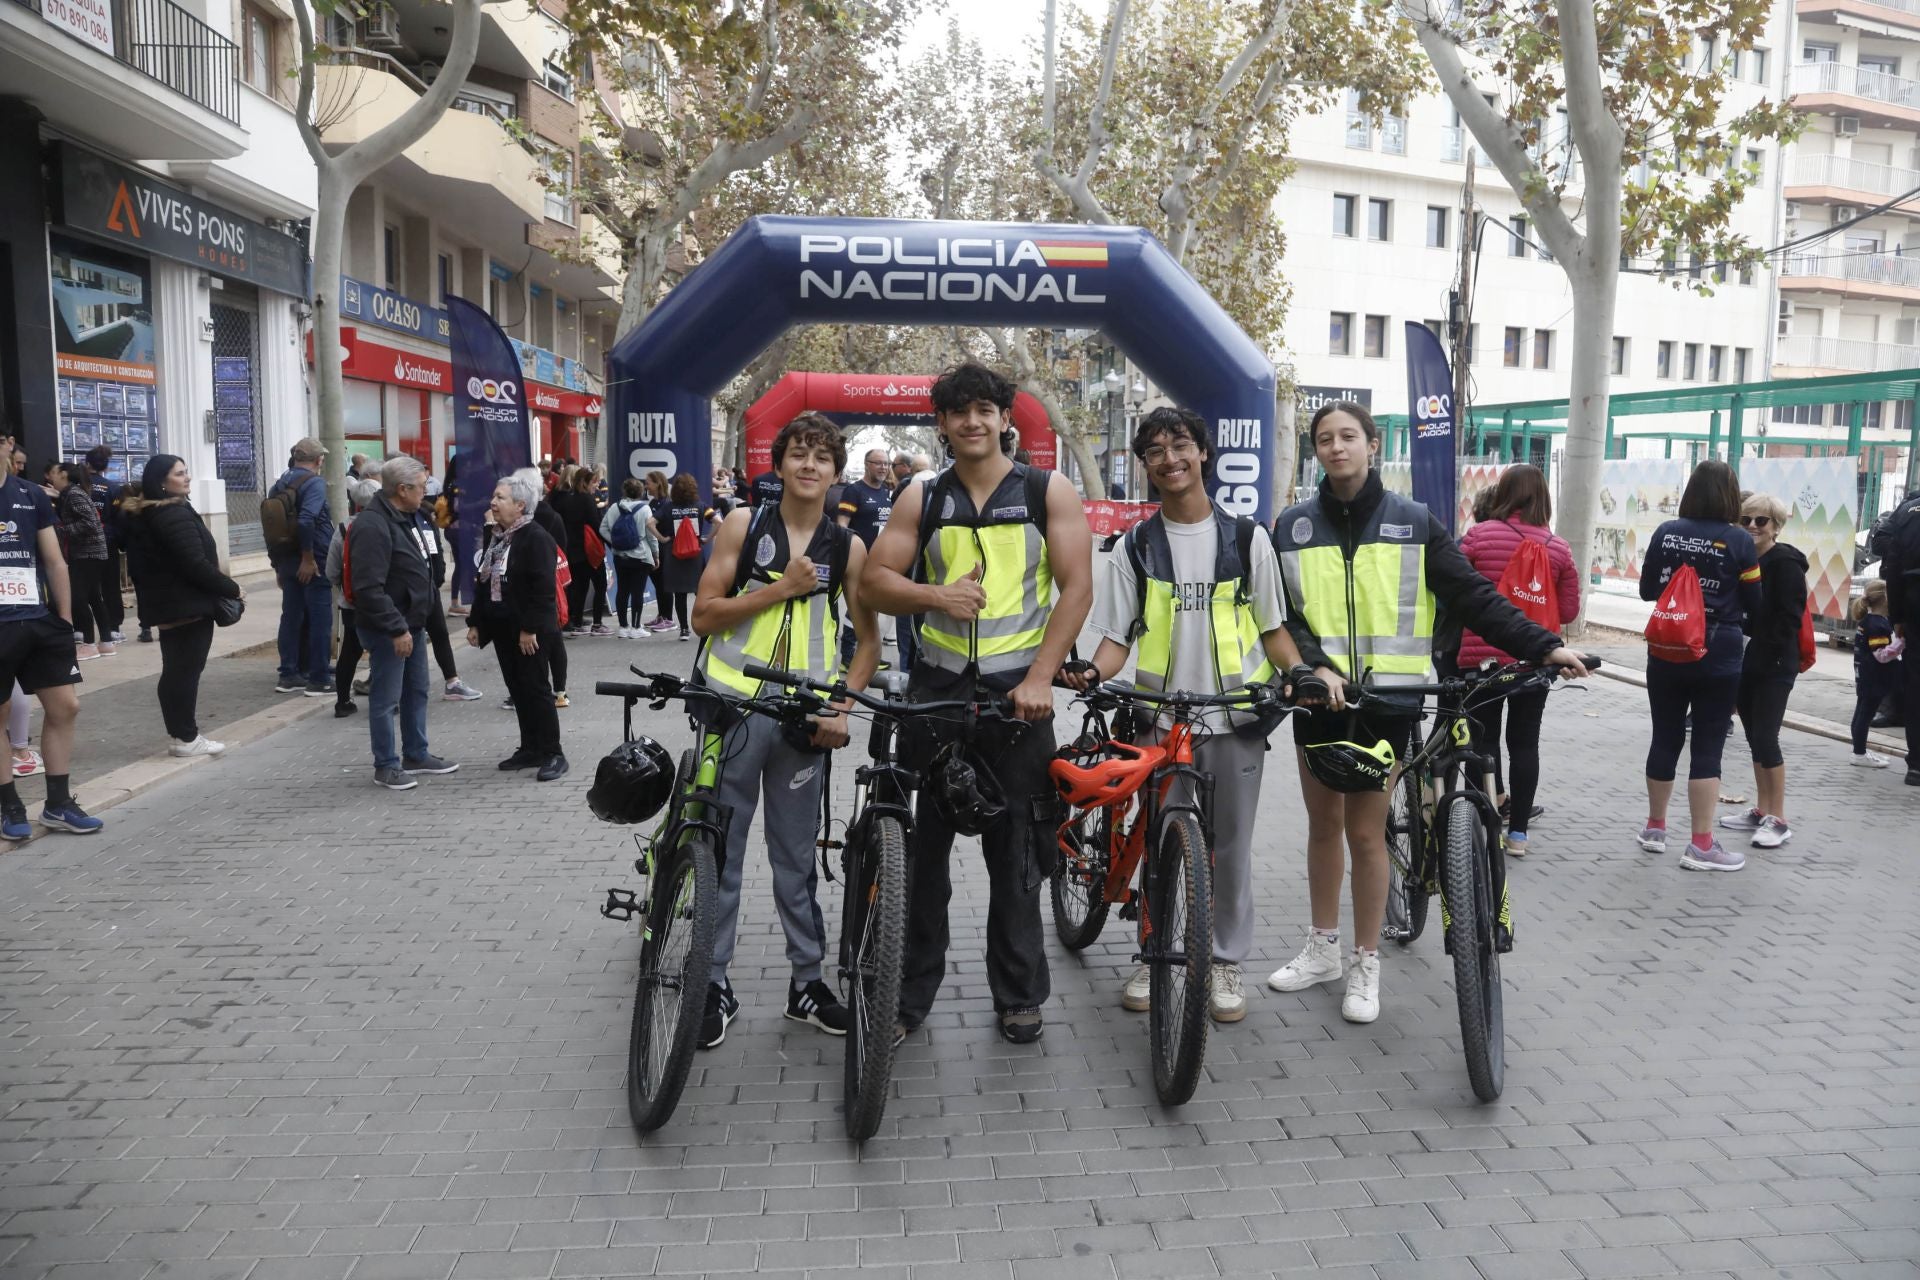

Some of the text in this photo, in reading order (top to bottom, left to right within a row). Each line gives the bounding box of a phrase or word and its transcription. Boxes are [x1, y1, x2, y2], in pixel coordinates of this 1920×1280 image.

[47, 0, 109, 43] 670 890 086
[74, 0, 106, 19] QUILA
[135, 185, 245, 254] VIVES PONS
[198, 245, 246, 272] HOMES
[800, 269, 1106, 303] NACIONAL
[373, 293, 420, 331] OCASO
[65, 360, 72, 369] DE
[74, 361, 112, 375] ARQUITECTURA
[405, 361, 441, 386] Santander
[541, 392, 560, 408] Santander
[843, 383, 881, 398] Sports
[628, 412, 677, 443] RUTA
[1217, 418, 1261, 448] RUTA
[1662, 541, 1725, 557] NACIONAL
[1653, 607, 1688, 620] anander
